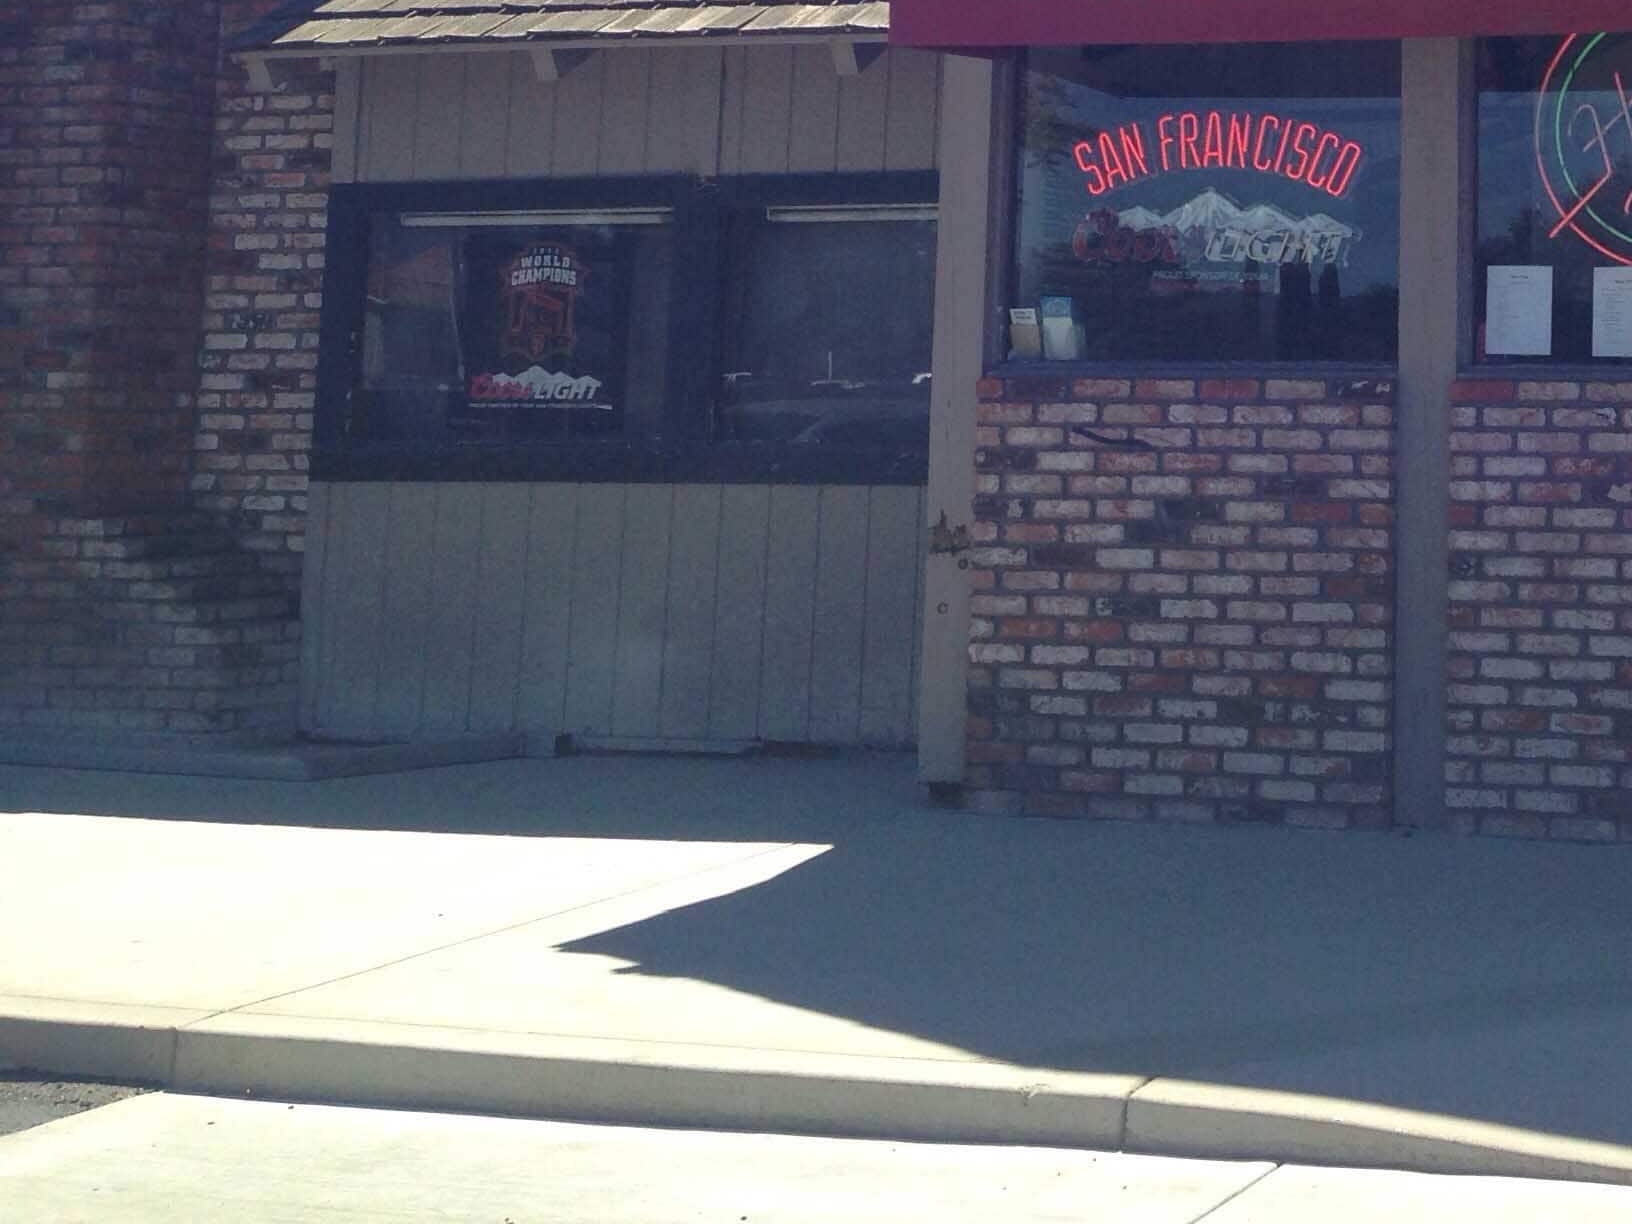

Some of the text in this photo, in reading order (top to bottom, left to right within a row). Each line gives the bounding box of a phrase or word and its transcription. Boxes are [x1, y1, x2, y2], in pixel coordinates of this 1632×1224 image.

[1072, 111, 1363, 196] SAN FRANCISCO
[521, 255, 571, 267] WORLD
[511, 267, 577, 286] CHAMPIONS
[533, 382, 601, 400] LIGHT
